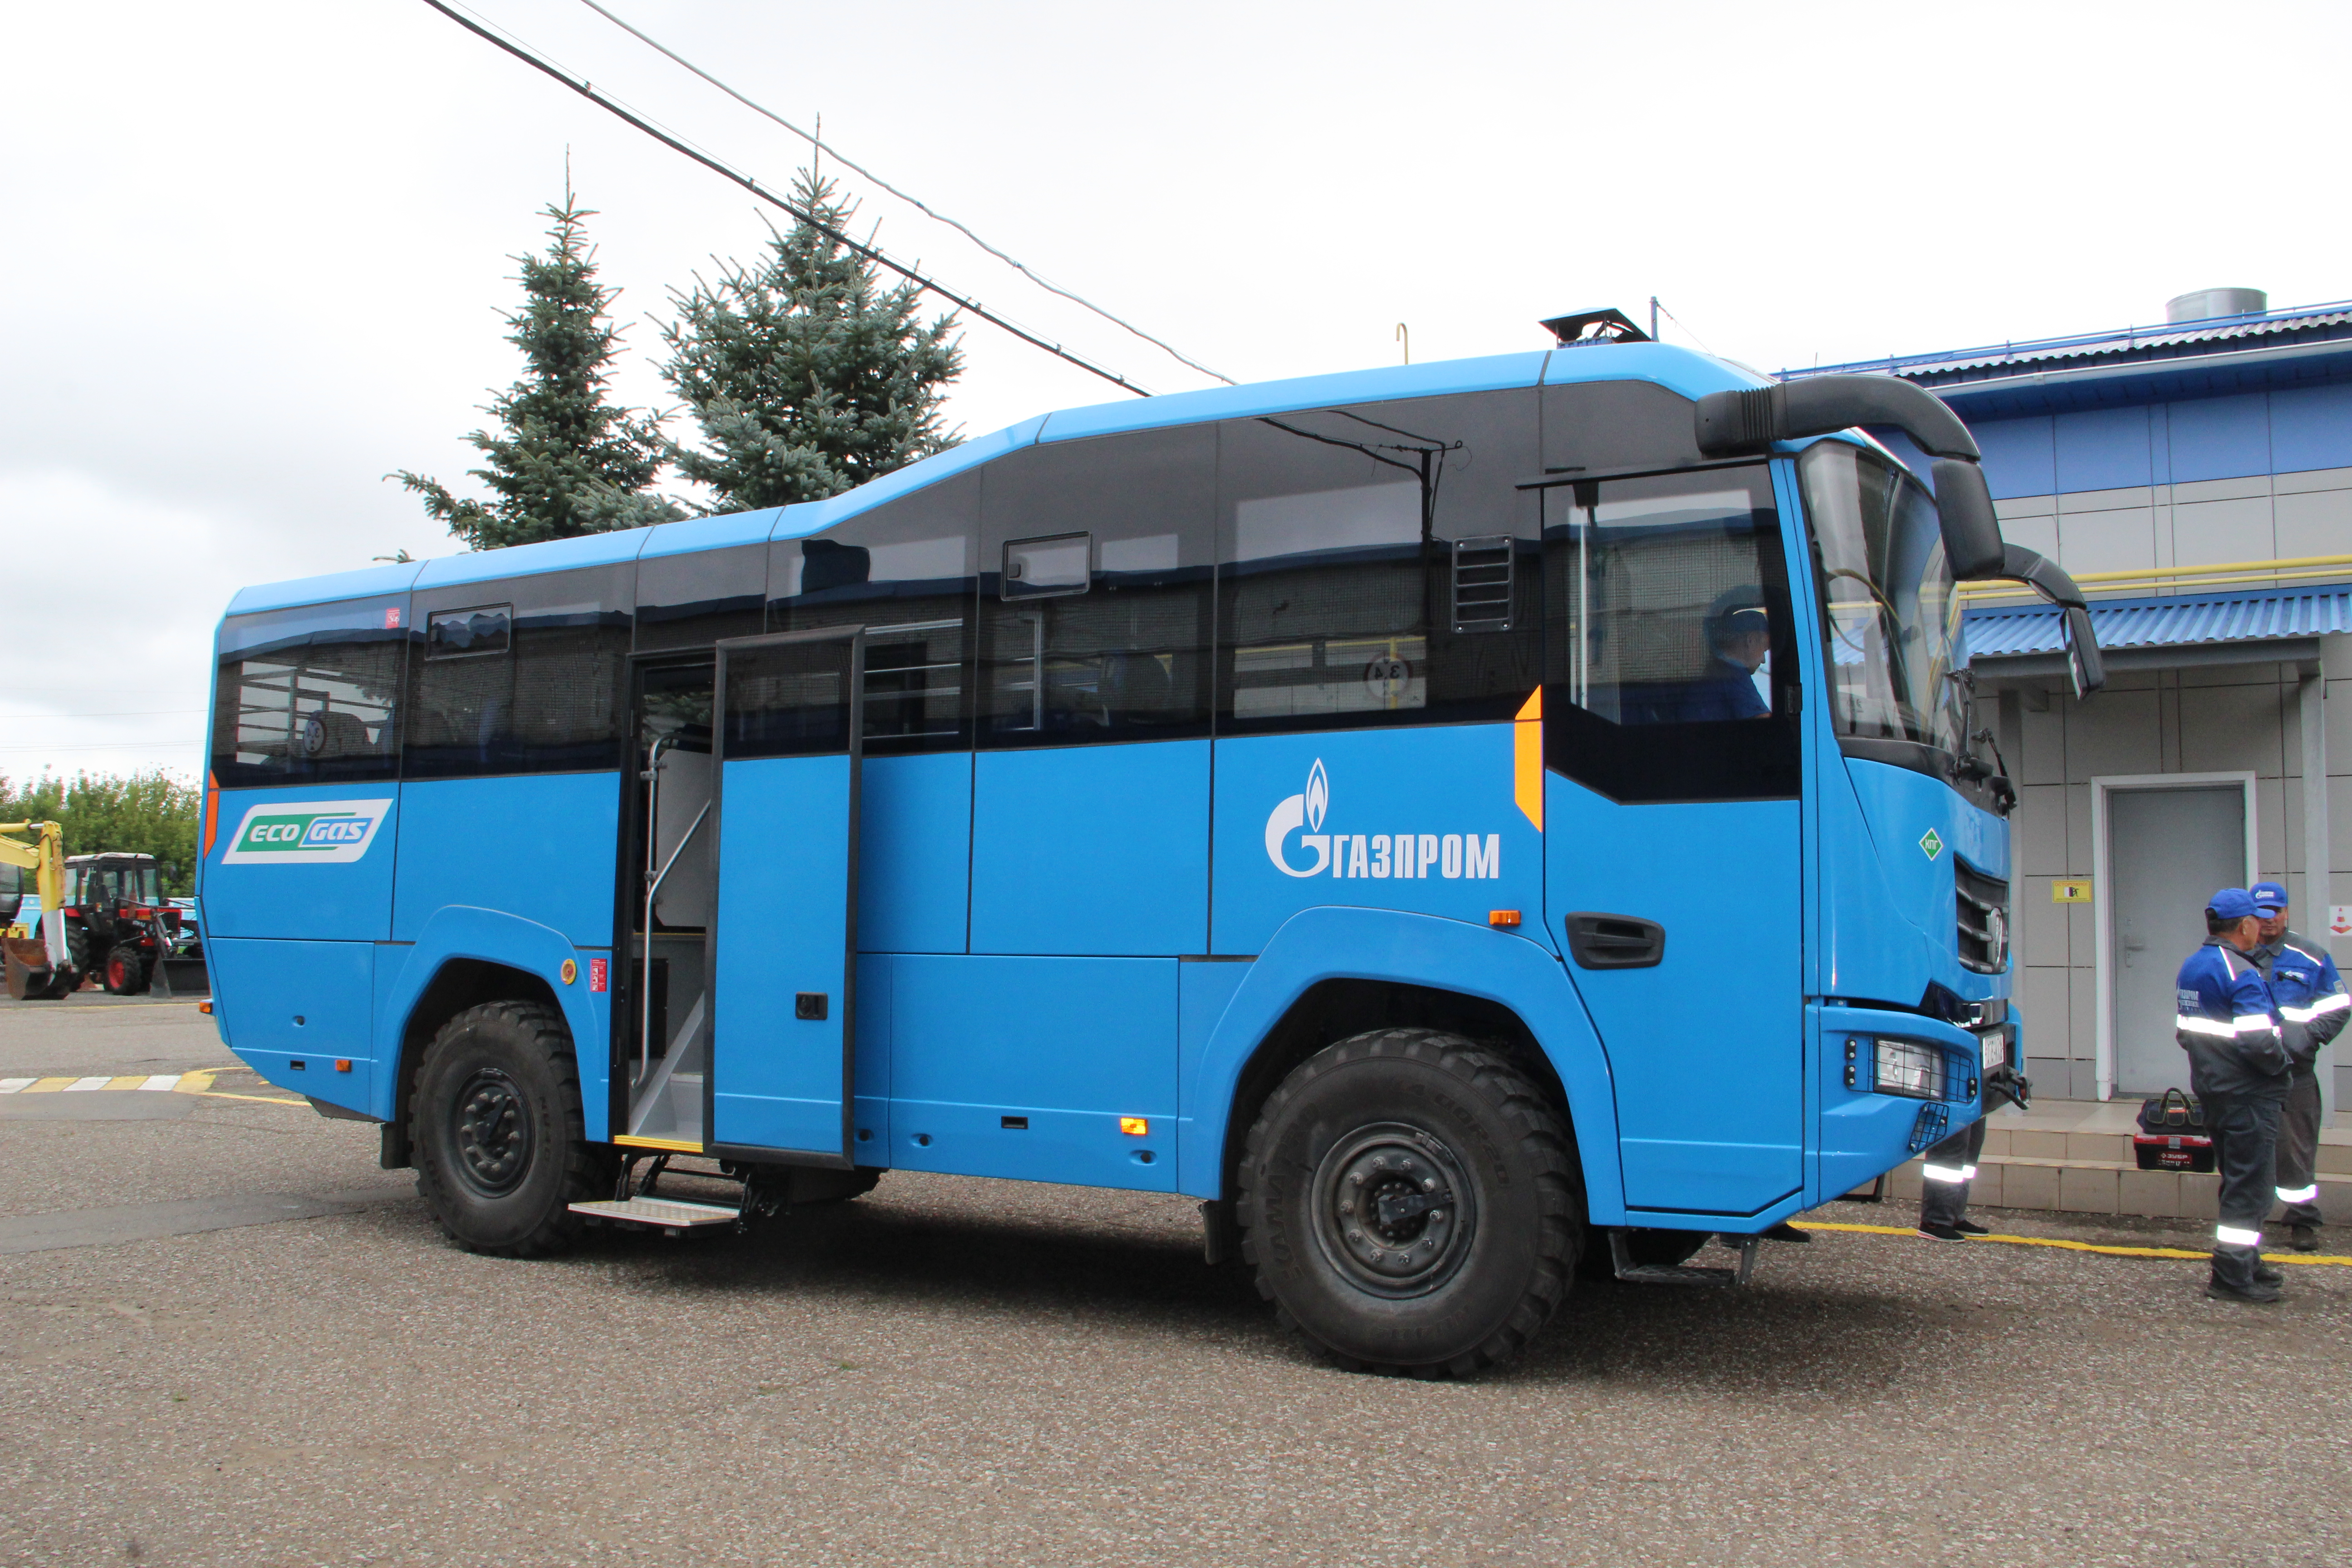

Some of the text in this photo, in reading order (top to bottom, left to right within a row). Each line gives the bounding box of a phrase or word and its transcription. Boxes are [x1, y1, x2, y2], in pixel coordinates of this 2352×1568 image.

[250, 824, 300, 842] ECO
[1925, 839, 1938, 850] КПГ
[1333, 833, 1499, 879] ГАЗПРОМ
